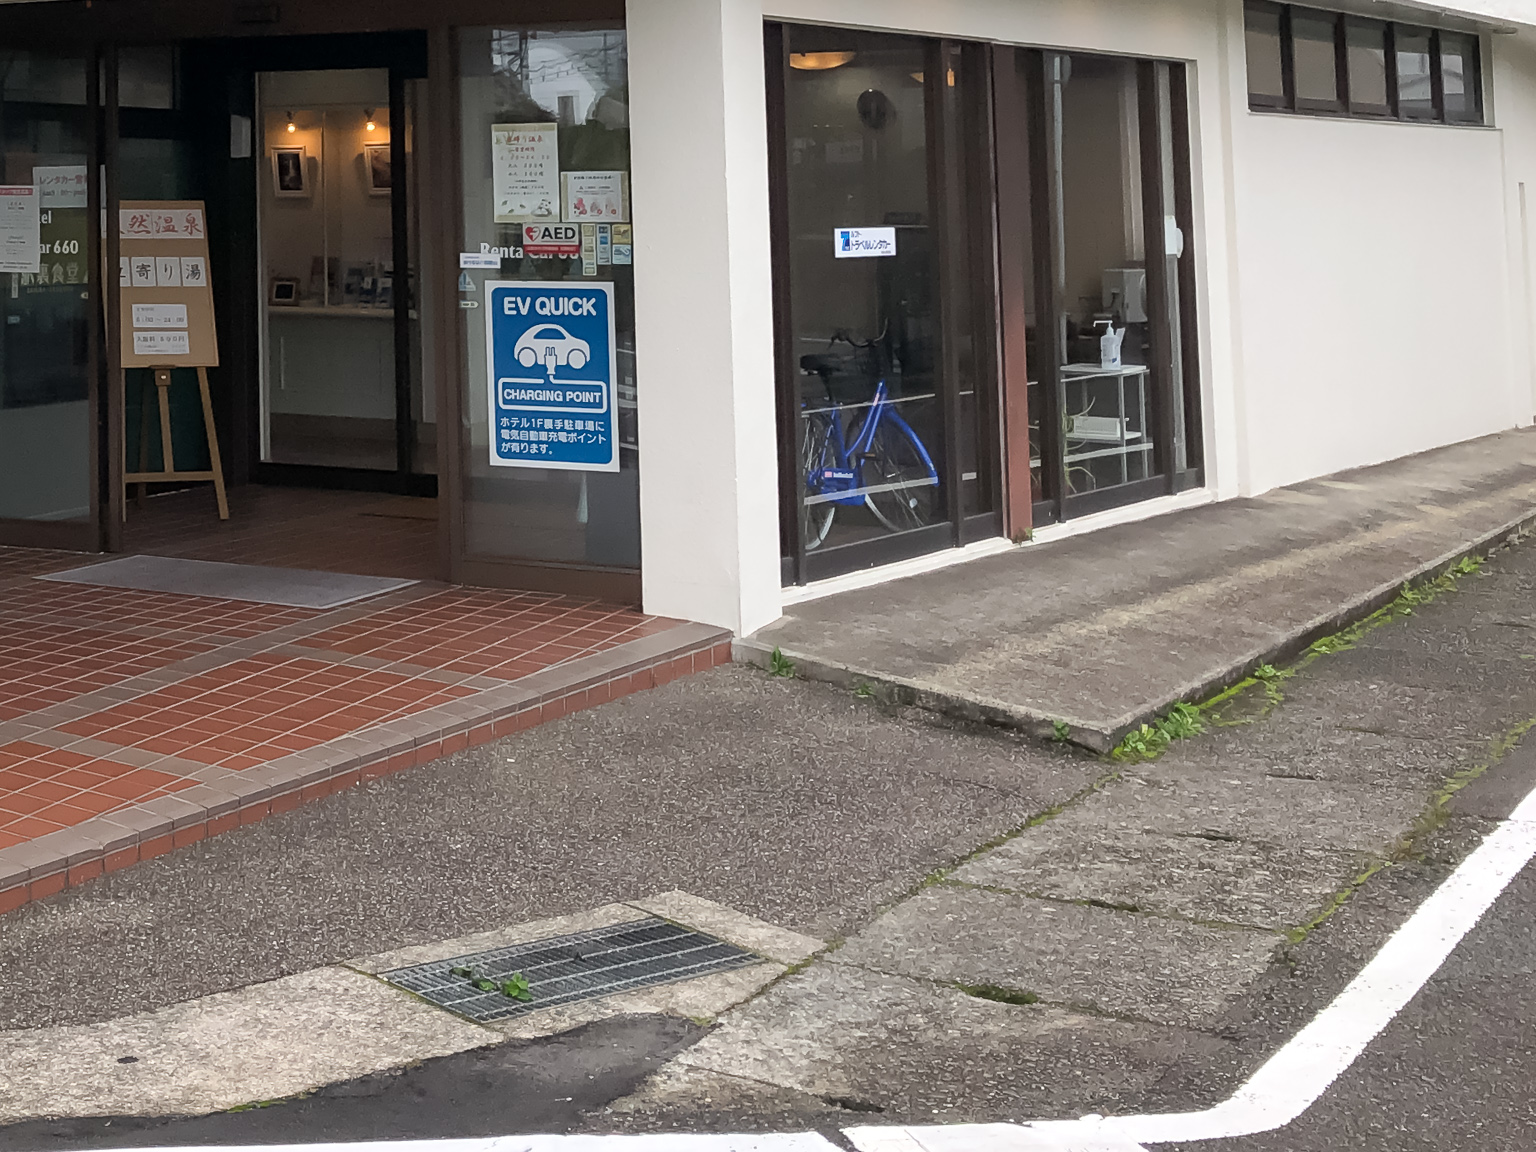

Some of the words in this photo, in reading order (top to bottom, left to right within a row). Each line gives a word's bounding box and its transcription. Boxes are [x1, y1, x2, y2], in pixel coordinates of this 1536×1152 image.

[120, 212, 202, 236] 然温泉
[541, 226, 576, 240] AED
[53, 240, 79, 254] 660
[480, 242, 523, 258] Renta
[503, 296, 531, 316] EV
[535, 296, 597, 316] QUICK
[504, 389, 563, 402] CHARGING
[566, 391, 601, 403] POINT
[501, 430, 606, 444] 電気自動車充電ポイント
[501, 442, 554, 455] が有ります。
